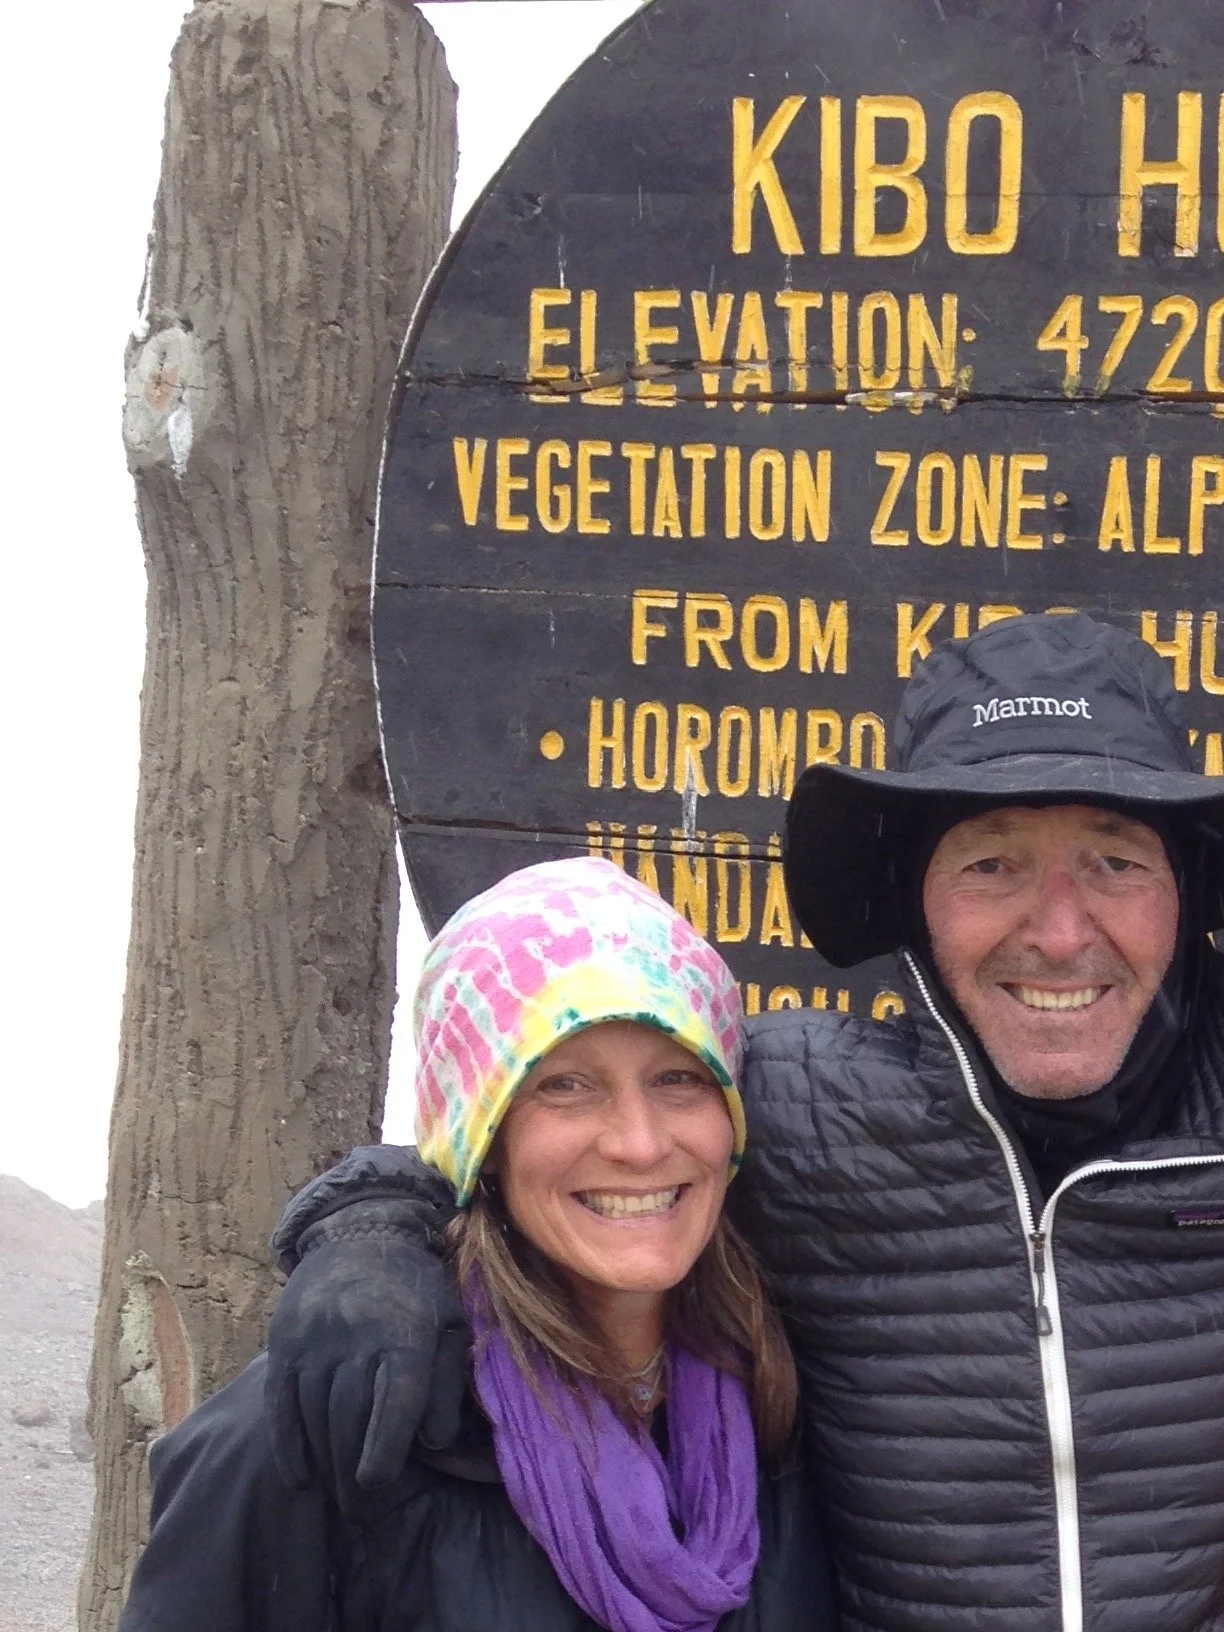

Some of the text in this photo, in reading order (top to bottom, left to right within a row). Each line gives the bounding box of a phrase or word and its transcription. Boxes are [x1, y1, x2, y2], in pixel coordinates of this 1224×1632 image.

[732, 91, 1024, 258] KIBO
[528, 287, 975, 415] ELEVATION:
[453, 437, 832, 543] VEGETATION
[872, 451, 1066, 550] ZONE:
[631, 589, 850, 674] FROM
[972, 696, 1093, 728] Marmot
